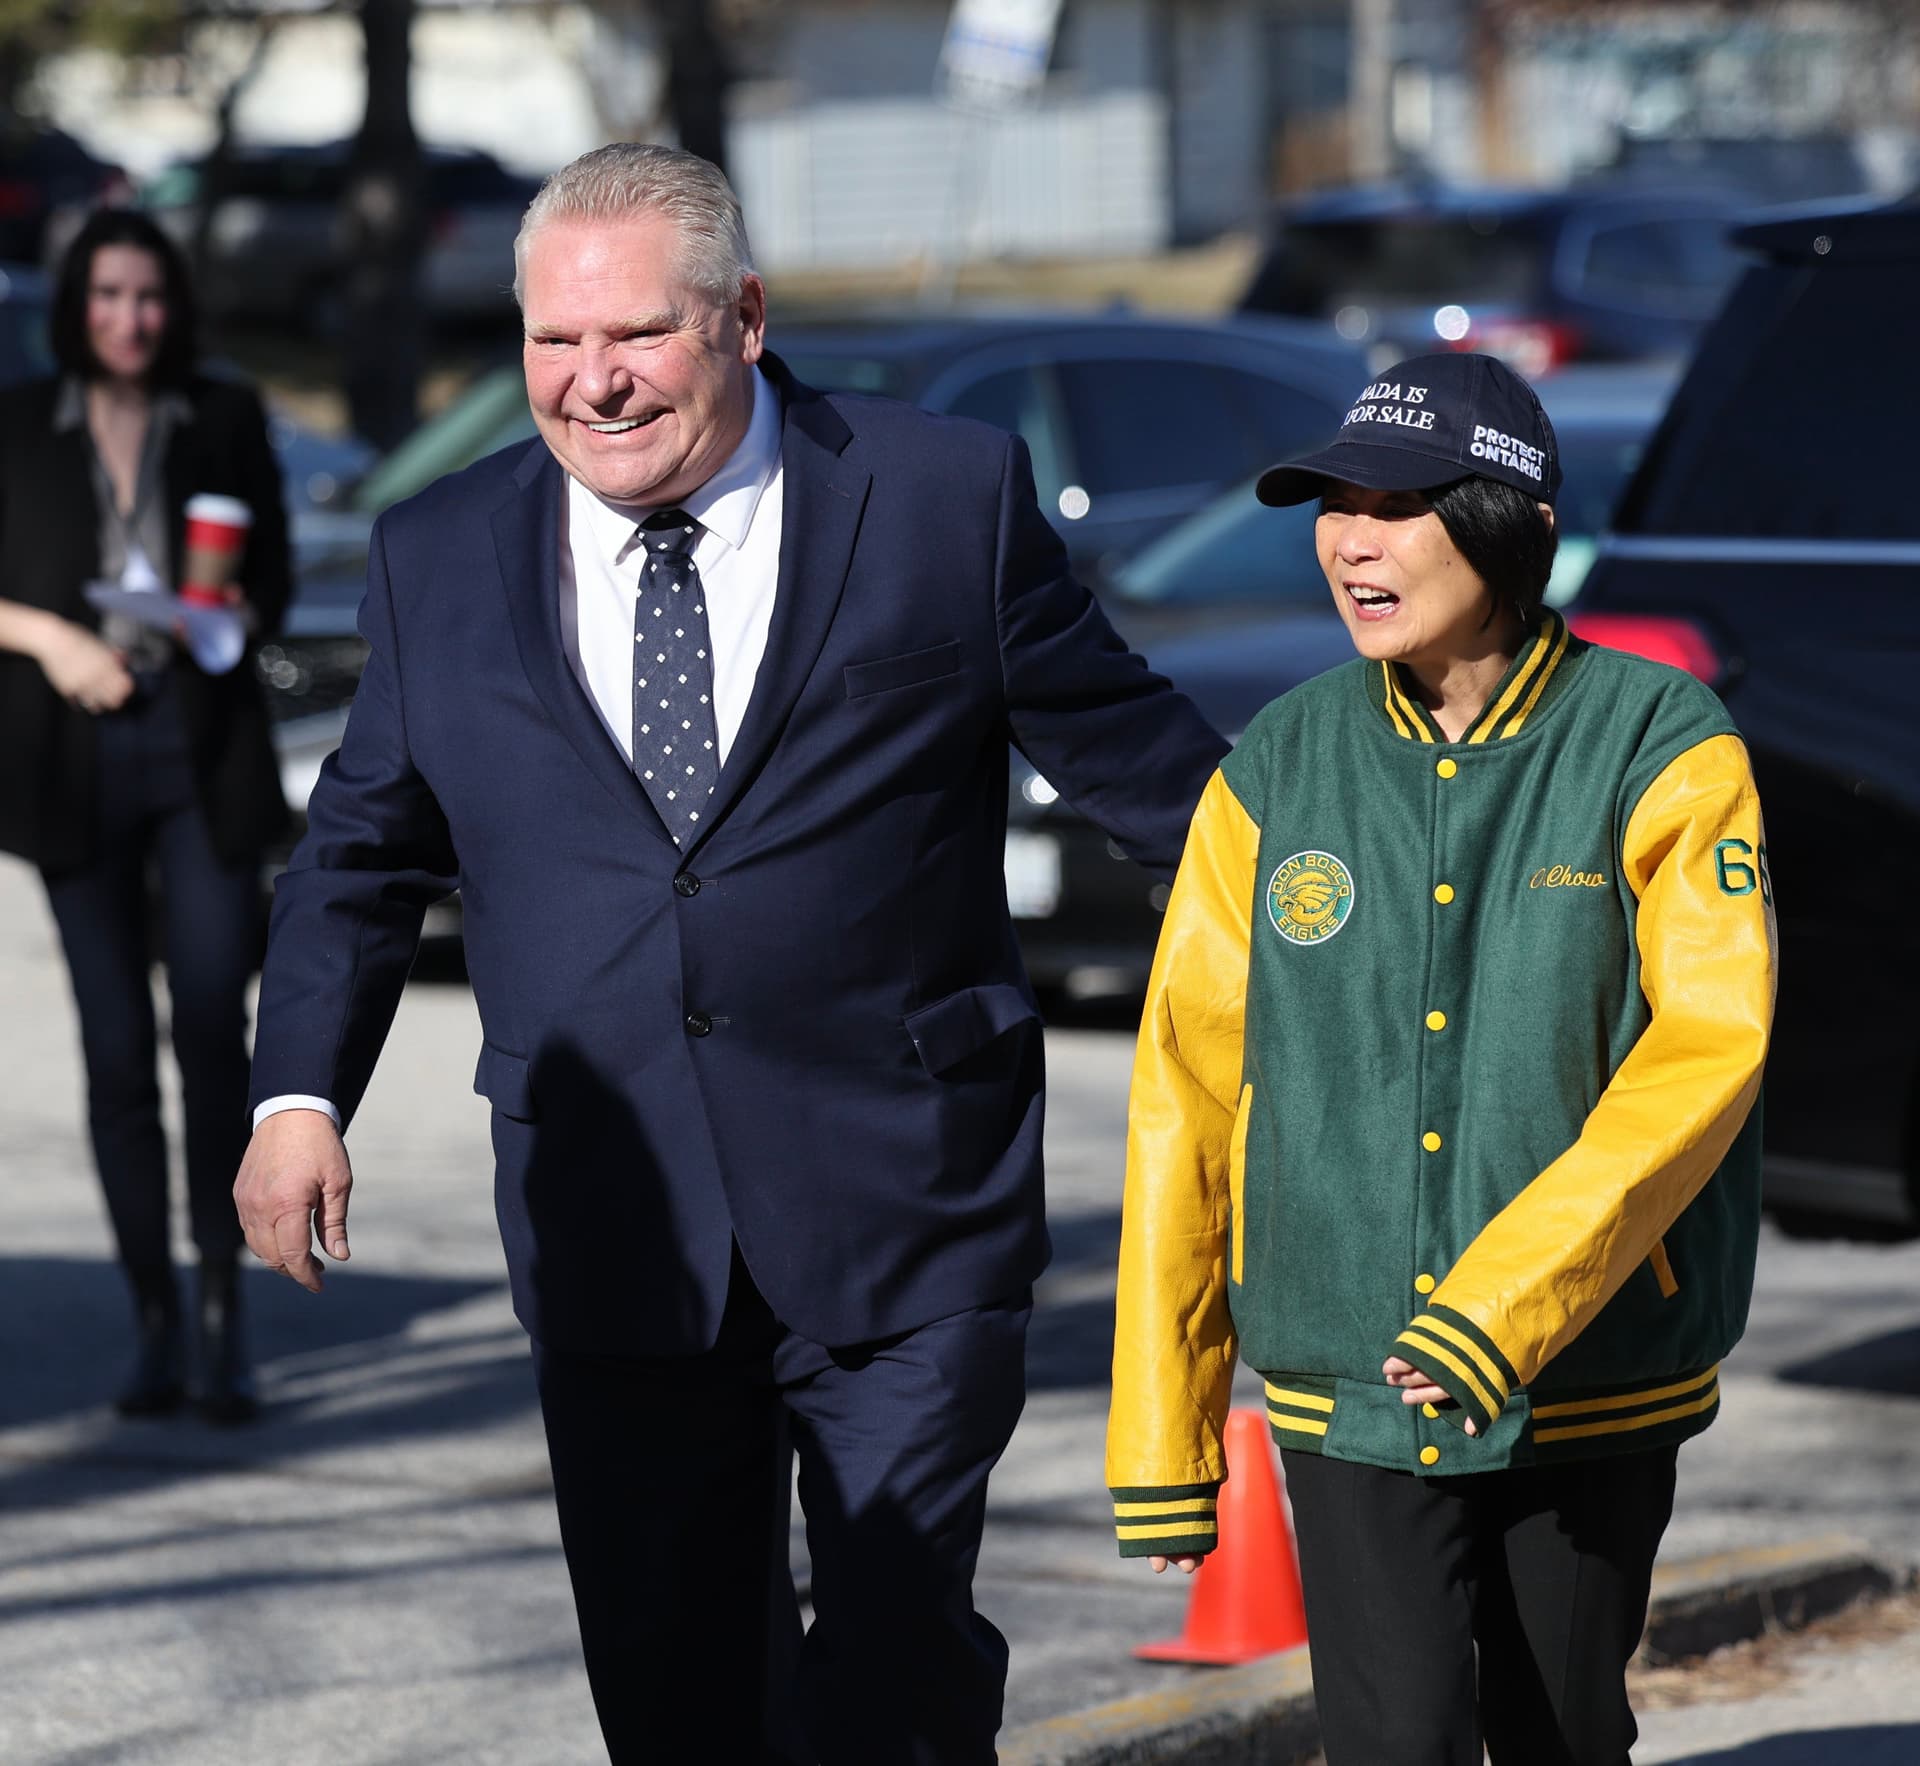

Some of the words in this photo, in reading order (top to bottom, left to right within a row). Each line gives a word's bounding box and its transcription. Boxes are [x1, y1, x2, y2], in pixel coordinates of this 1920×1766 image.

[1354, 383, 1401, 405] NADA
[1402, 386, 1428, 404] IS
[1346, 405, 1377, 424] FOR
[1375, 406, 1435, 430] SALE
[1473, 424, 1545, 466] PROTECT
[1470, 442, 1542, 481] ONTARIO
[1272, 859, 1301, 894] DON
[1305, 855, 1350, 897] BOSCO
[1278, 915, 1339, 940] EAGLES
